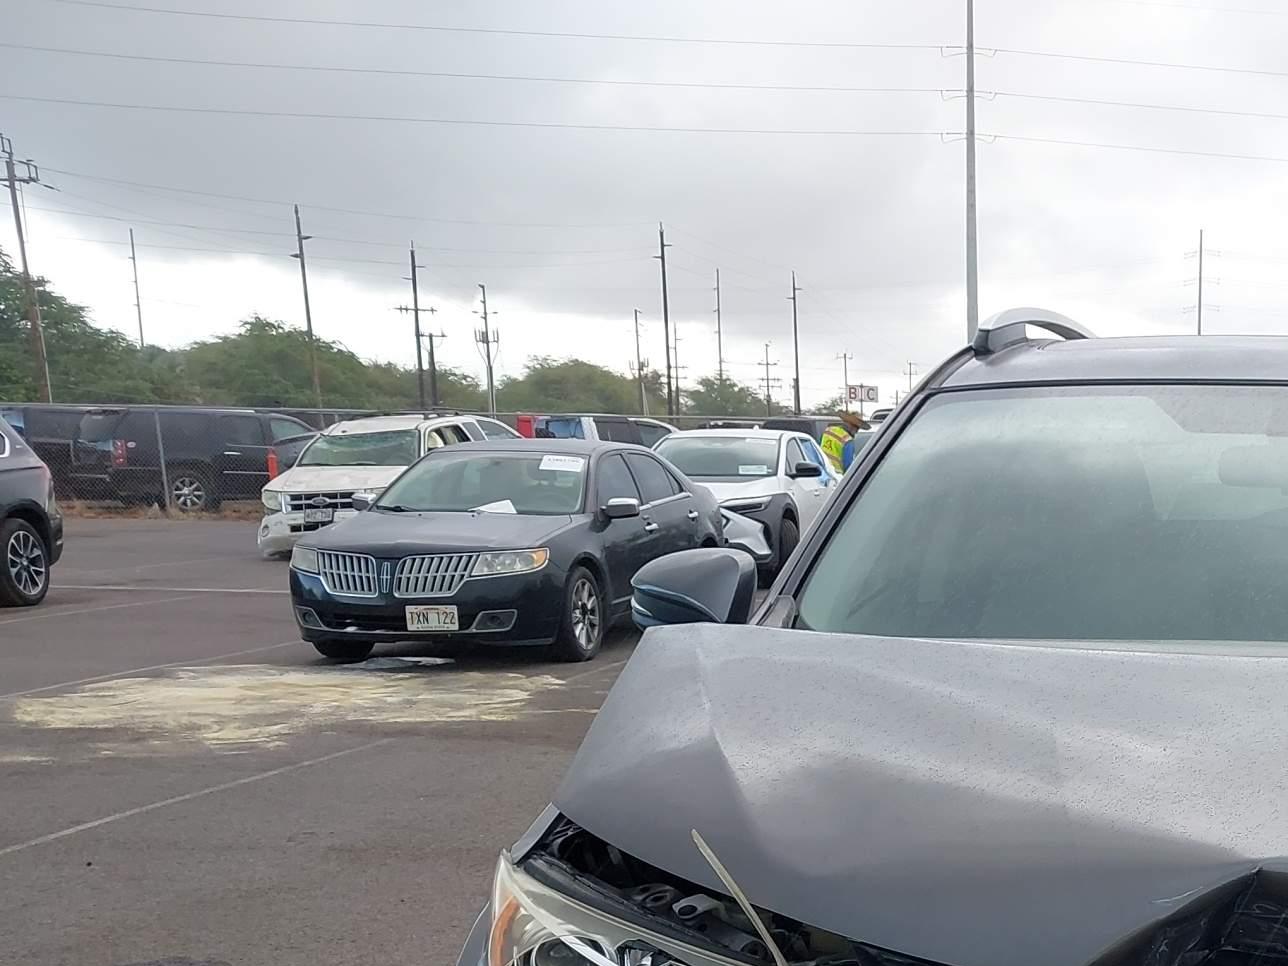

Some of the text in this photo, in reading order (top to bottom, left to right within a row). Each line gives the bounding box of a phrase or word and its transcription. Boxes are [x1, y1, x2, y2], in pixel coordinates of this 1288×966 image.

[848, 386, 876, 401] B C
[408, 611, 456, 625] TXN 122
